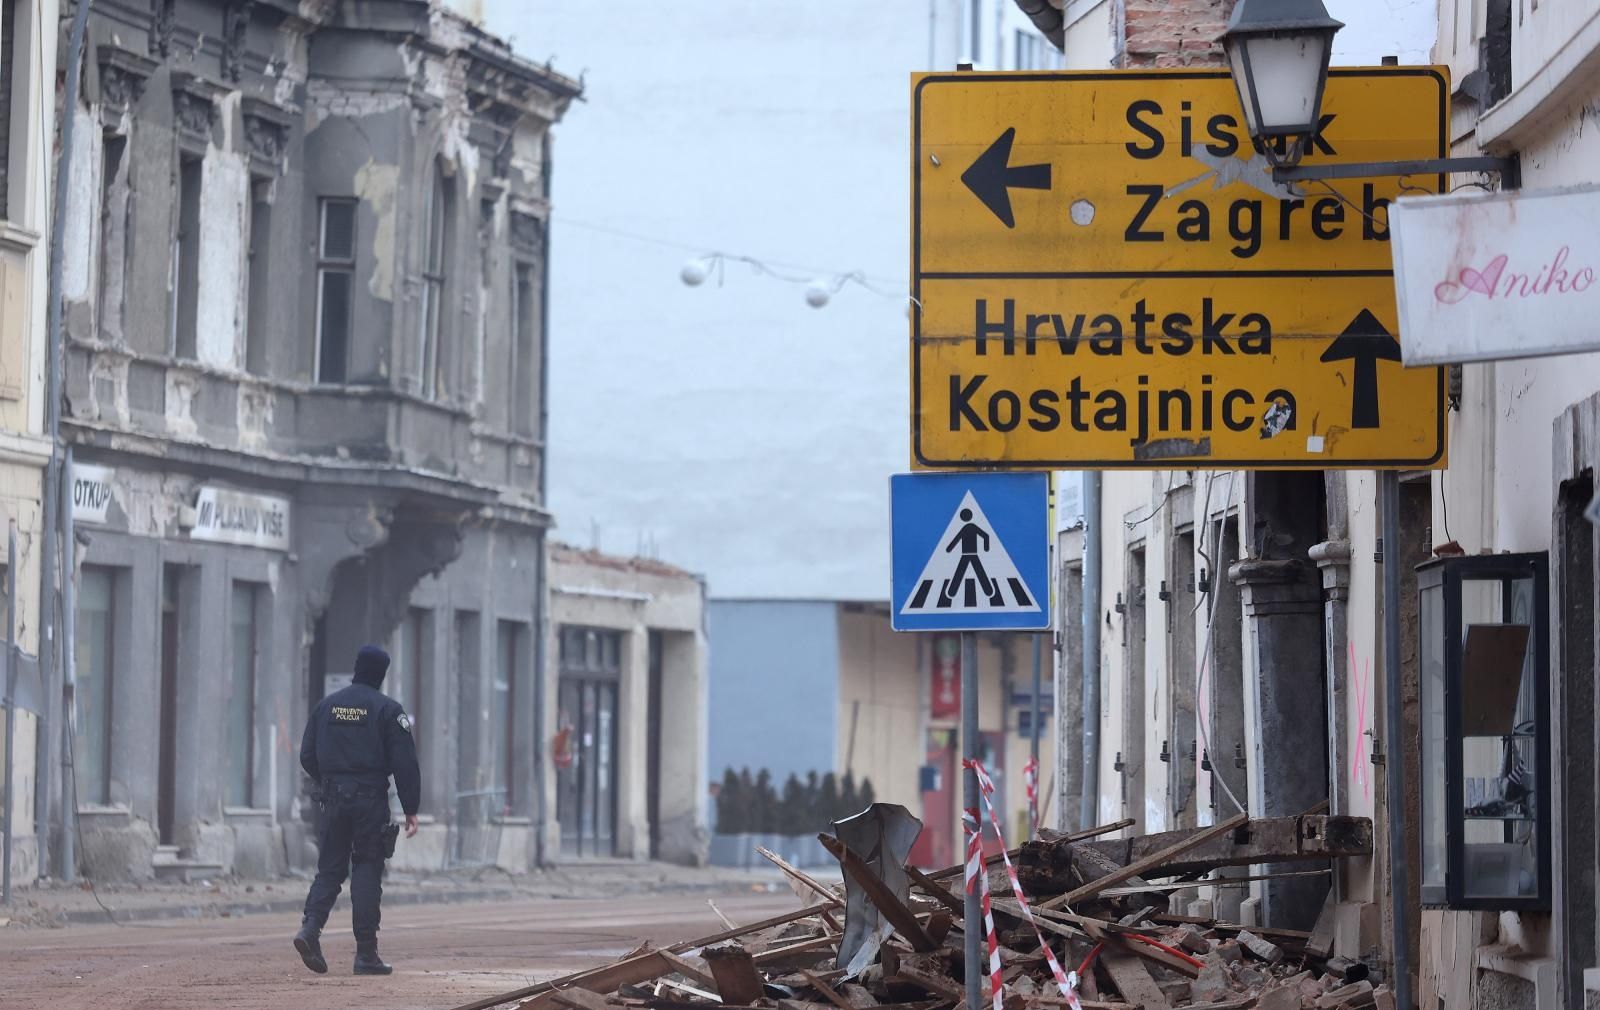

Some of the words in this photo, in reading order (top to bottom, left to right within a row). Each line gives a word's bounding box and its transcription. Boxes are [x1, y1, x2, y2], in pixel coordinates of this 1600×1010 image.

[1125, 183, 1392, 259] Zagreb
[1434, 245, 1595, 304] Aniko
[975, 297, 1272, 356] Hrvatska
[949, 374, 1297, 447] Kostajnica
[74, 479, 111, 510] OTKUP
